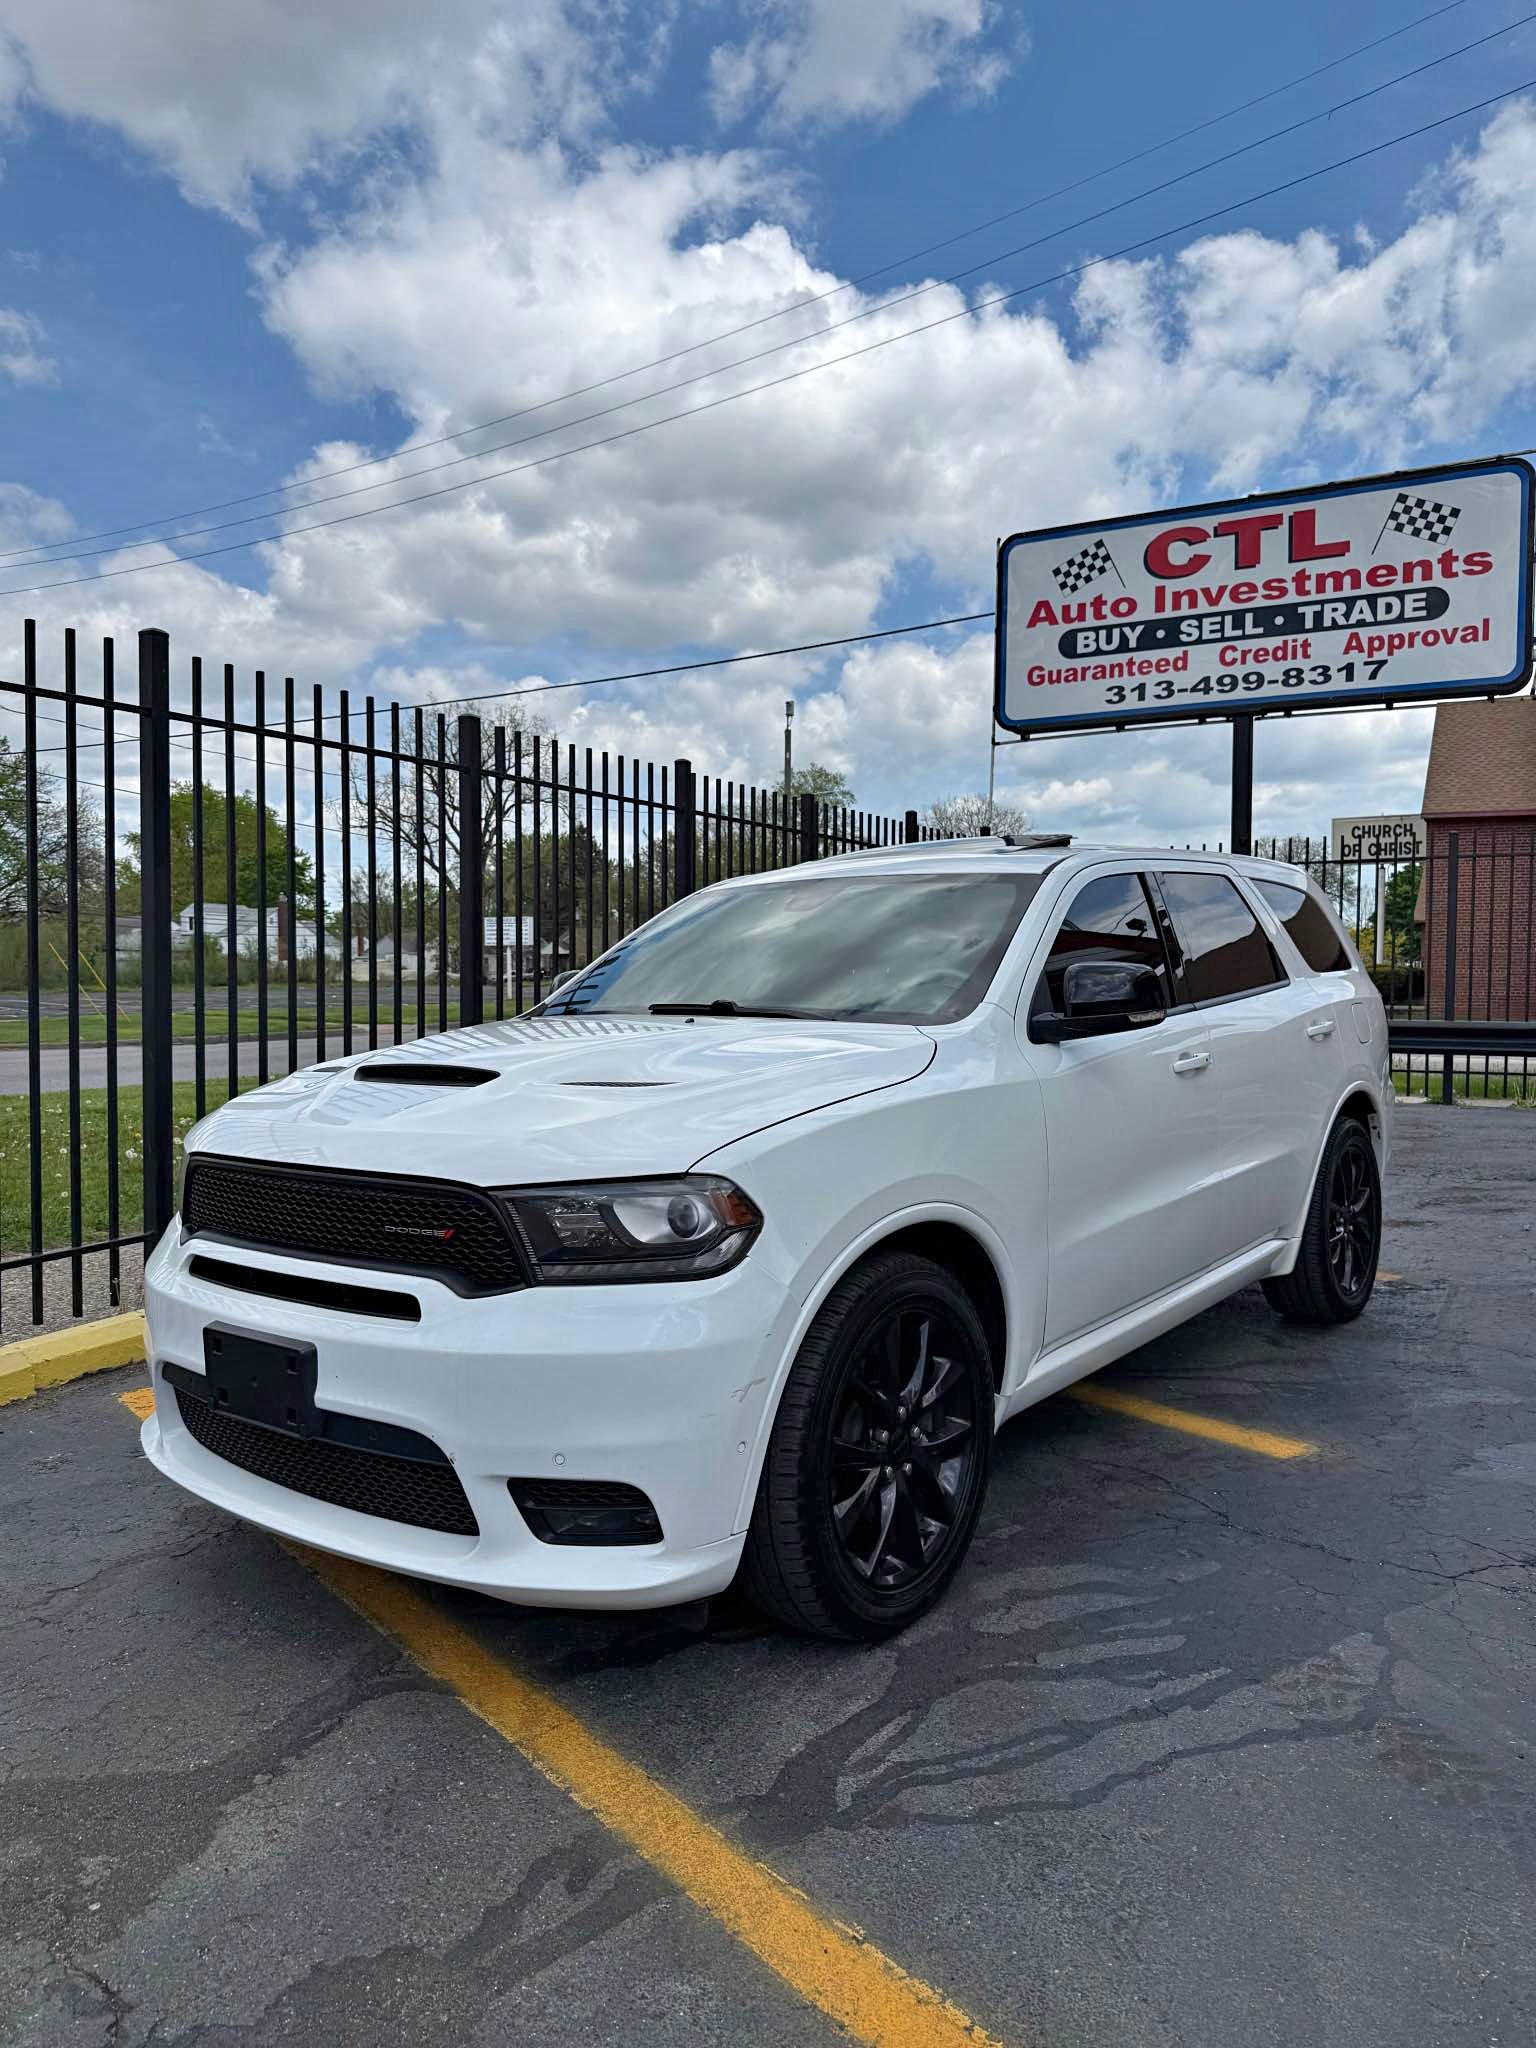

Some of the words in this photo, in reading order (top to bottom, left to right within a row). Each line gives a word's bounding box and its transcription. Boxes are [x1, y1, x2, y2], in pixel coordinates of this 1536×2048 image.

[1144, 508, 1351, 580] CTL
[1026, 593, 1138, 628] Auto
[1154, 548, 1494, 613] Investments
[1026, 650, 1189, 688] Guaranteed
[1218, 638, 1312, 667] Credit
[1342, 618, 1491, 659] Approval
[1075, 624, 1145, 655] BUY
[1178, 612, 1264, 642] SELL
[1298, 591, 1428, 627] TRADE
[1104, 658, 1389, 705] 313-499-8317
[1351, 823, 1414, 840] CHURCH
[384, 1225, 446, 1237] DODGE
